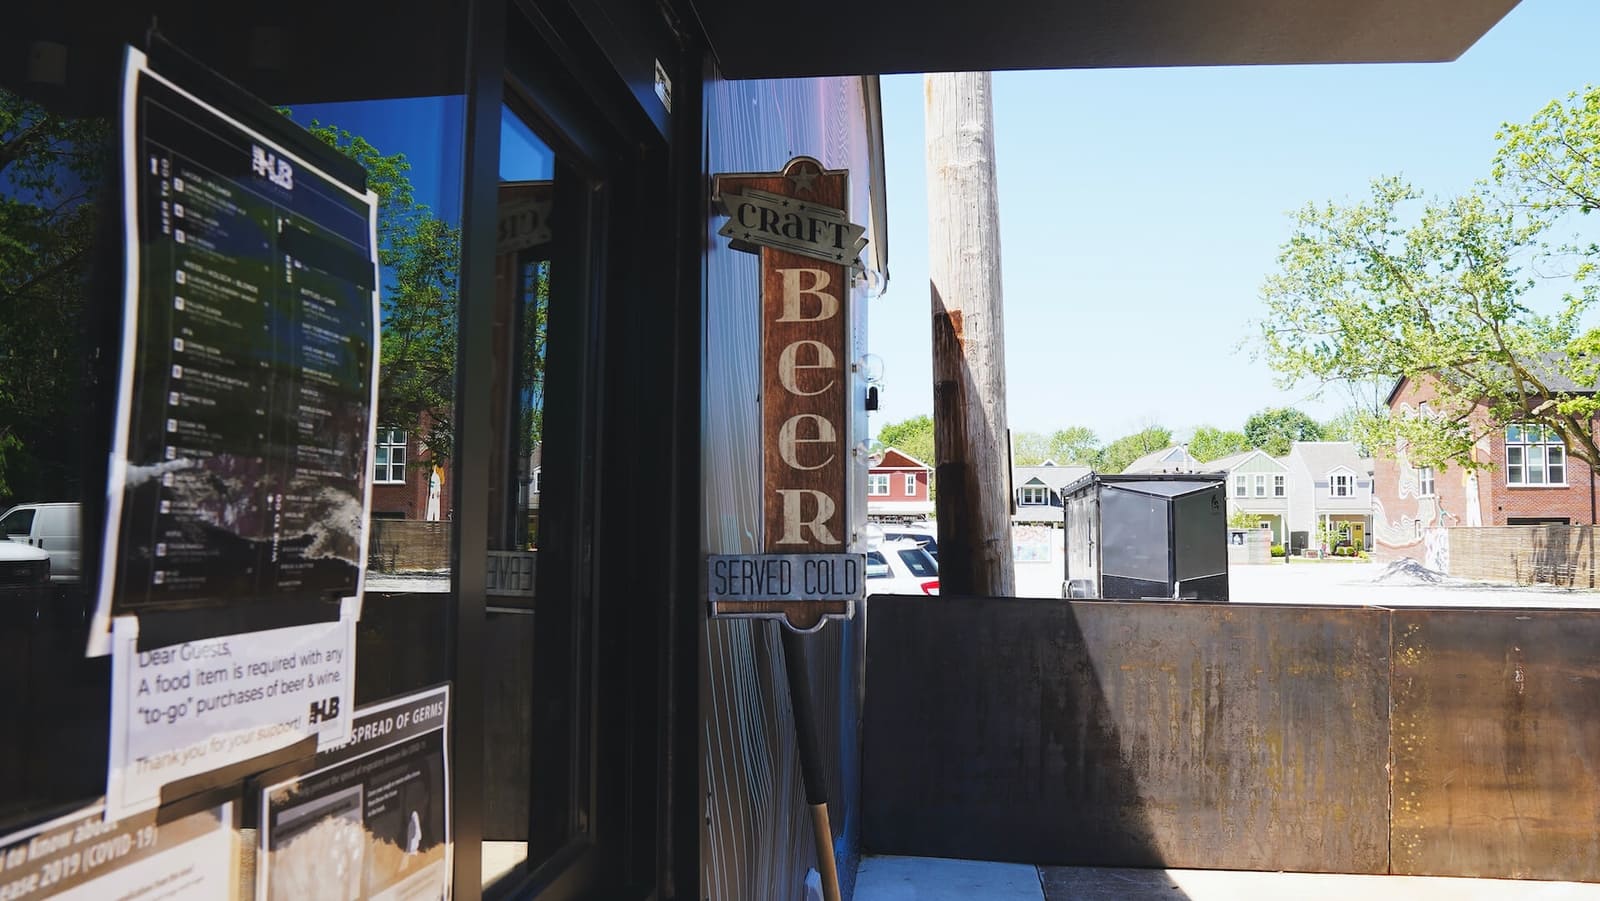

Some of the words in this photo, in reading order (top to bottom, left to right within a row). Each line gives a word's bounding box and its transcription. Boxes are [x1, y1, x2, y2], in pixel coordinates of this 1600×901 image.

[715, 559, 791, 596] SERVED
[804, 559, 856, 597] COLD
[138, 678, 150, 696] A
[156, 669, 191, 693] food
[196, 668, 228, 687] item
[233, 661, 243, 680] is
[247, 653, 297, 677] required
[299, 647, 322, 667] with
[325, 648, 343, 664] any
[139, 649, 176, 668] Dear
[196, 687, 264, 718] purchases
[267, 680, 279, 697] of
[281, 676, 305, 695] beer
[307, 673, 314, 688] &
[350, 717, 393, 745] SPREAD
[396, 712, 410, 730] OF
[412, 701, 444, 724] GERMS
[136, 750, 176, 774] Thank
[179, 742, 206, 767] you
[209, 735, 228, 753] for
[228, 731, 255, 753] your
[28, 829, 74, 862] know
[40, 852, 81, 888] 2019
[82, 824, 159, 873] (COVID-19)
